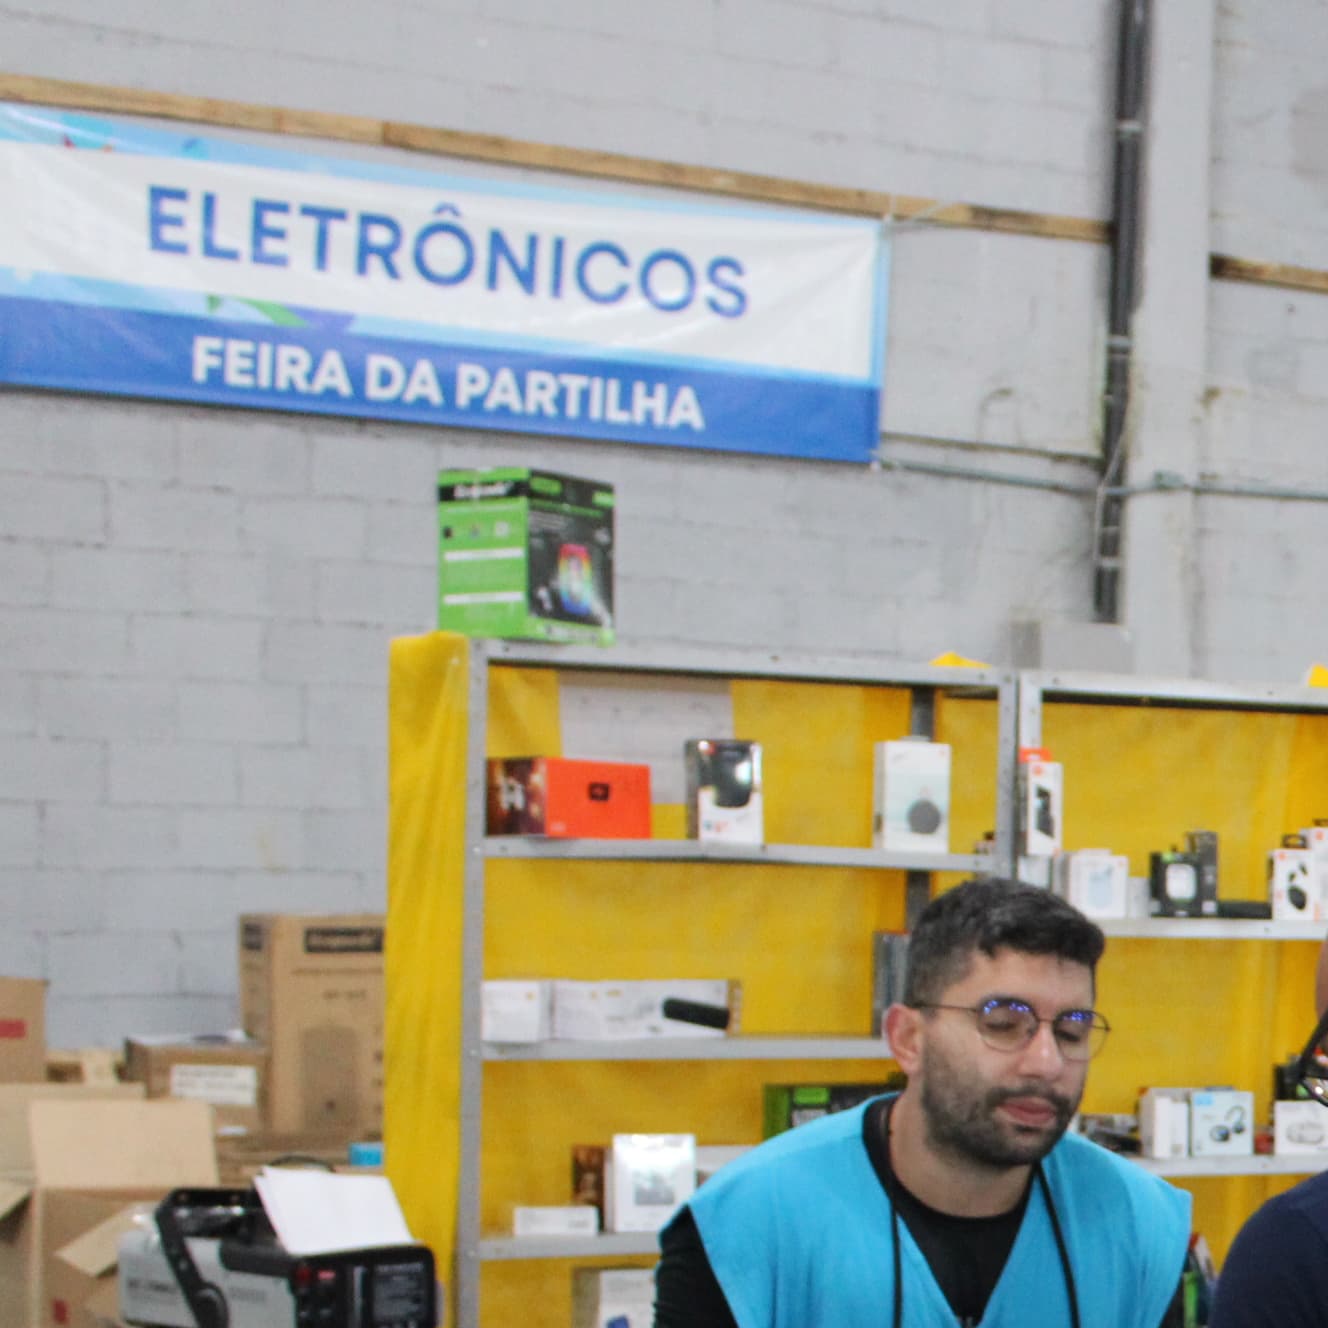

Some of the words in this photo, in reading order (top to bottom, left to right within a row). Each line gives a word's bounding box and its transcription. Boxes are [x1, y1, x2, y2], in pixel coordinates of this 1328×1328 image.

[148, 184, 749, 319] ELETRÔNICOS
[192, 335, 352, 397] FEIRA
[366, 354, 443, 405] DA
[456, 362, 705, 430] PARTILHA
